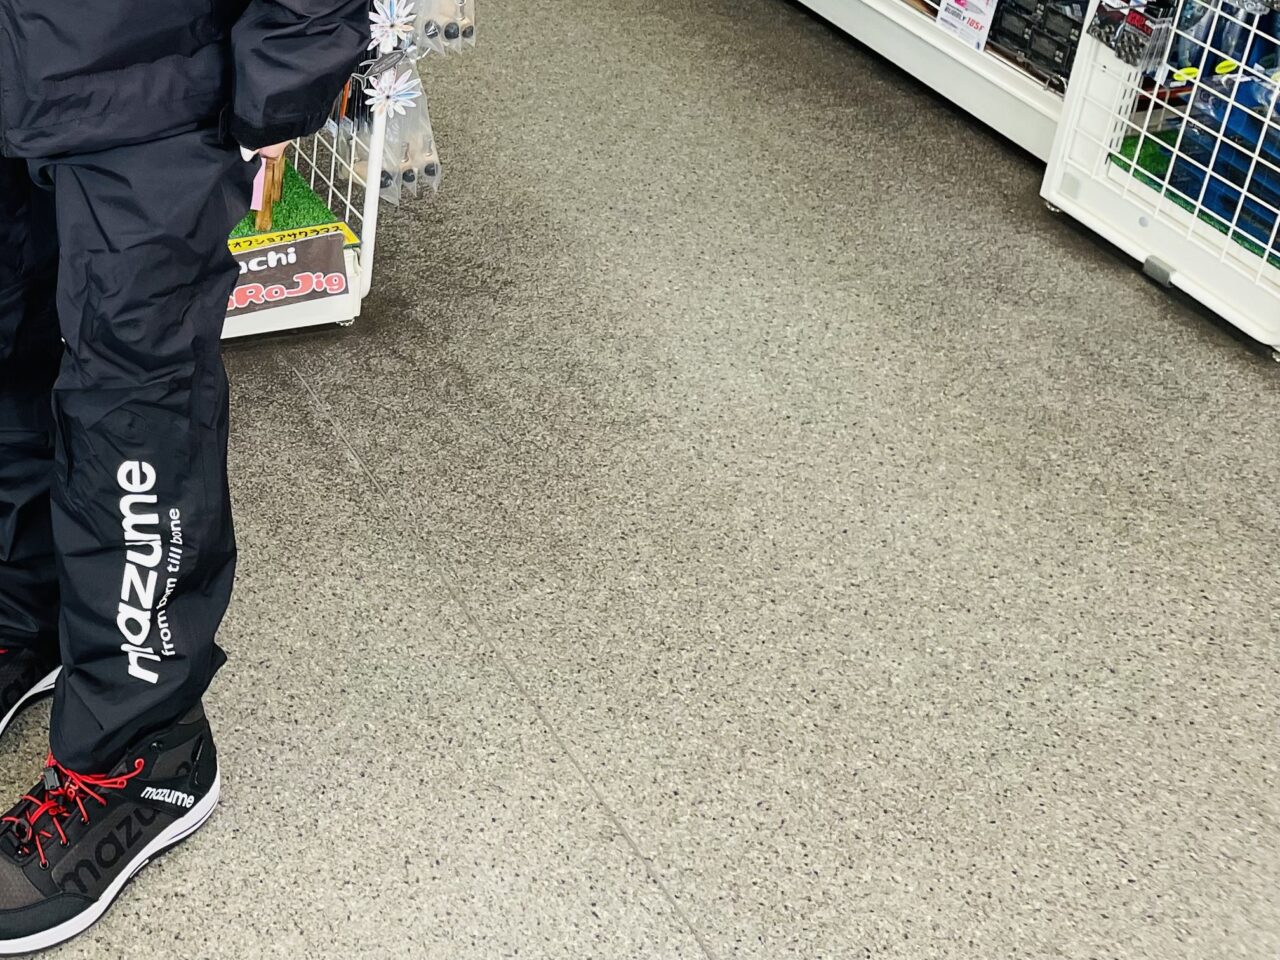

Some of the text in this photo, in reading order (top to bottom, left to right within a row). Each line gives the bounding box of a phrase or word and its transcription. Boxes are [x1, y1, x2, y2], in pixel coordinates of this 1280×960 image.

[233, 226, 342, 249] オフショアサクラマス
[227, 271, 346, 310] RaJig
[169, 507, 183, 545] bone
[117, 460, 163, 684] mazume
[166, 547, 183, 573] till
[158, 609, 176, 657] from
[141, 785, 195, 809] mazume
